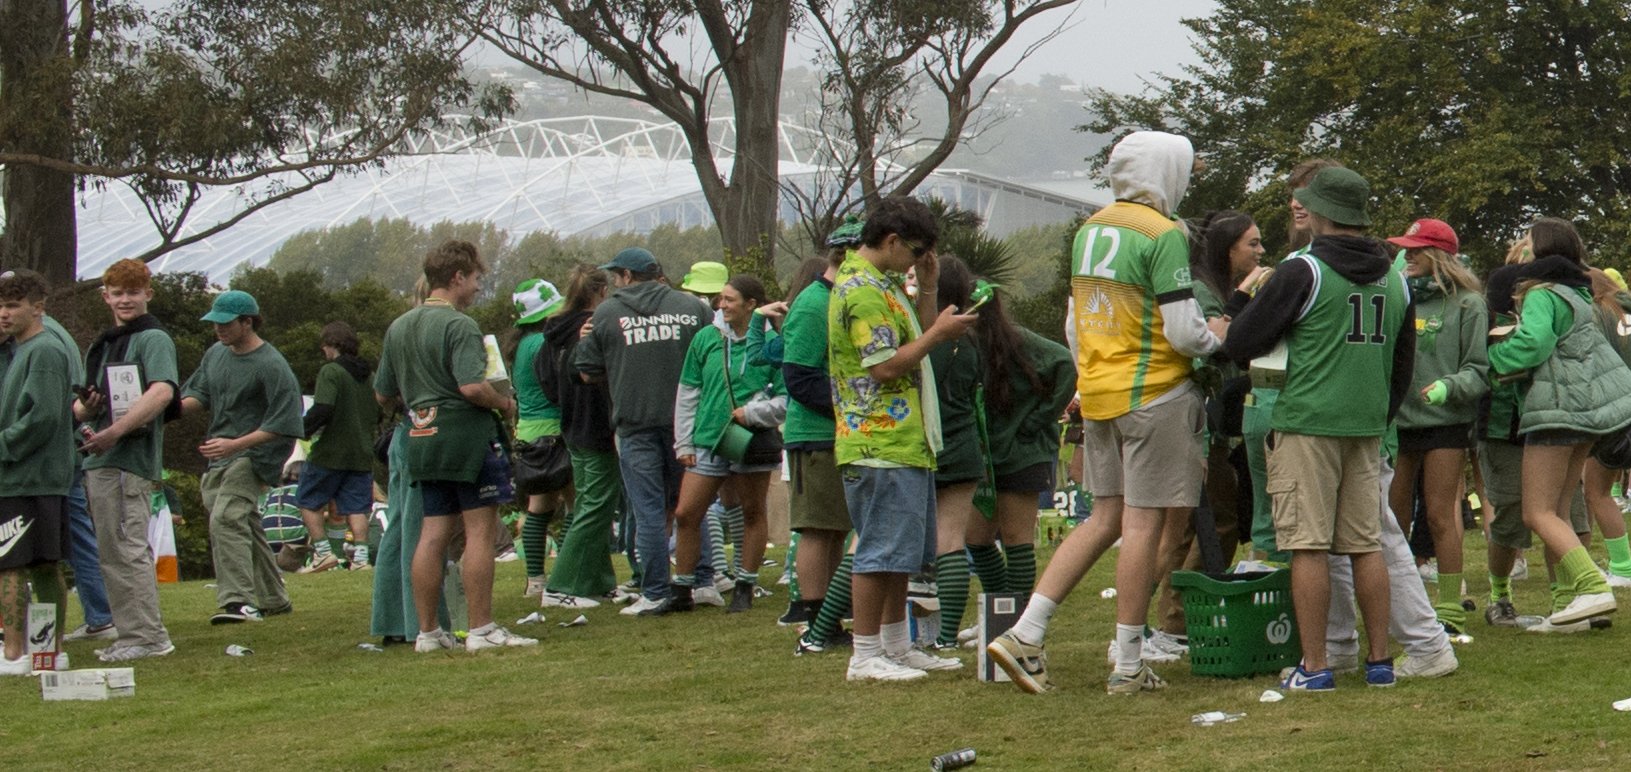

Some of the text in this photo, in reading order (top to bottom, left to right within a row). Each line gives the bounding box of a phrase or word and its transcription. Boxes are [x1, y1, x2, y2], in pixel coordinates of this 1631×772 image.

[1079, 226, 1121, 279] 12
[619, 313, 698, 330] BUNNINGS
[623, 324, 681, 346] TRADE
[1345, 292, 1387, 345] 11
